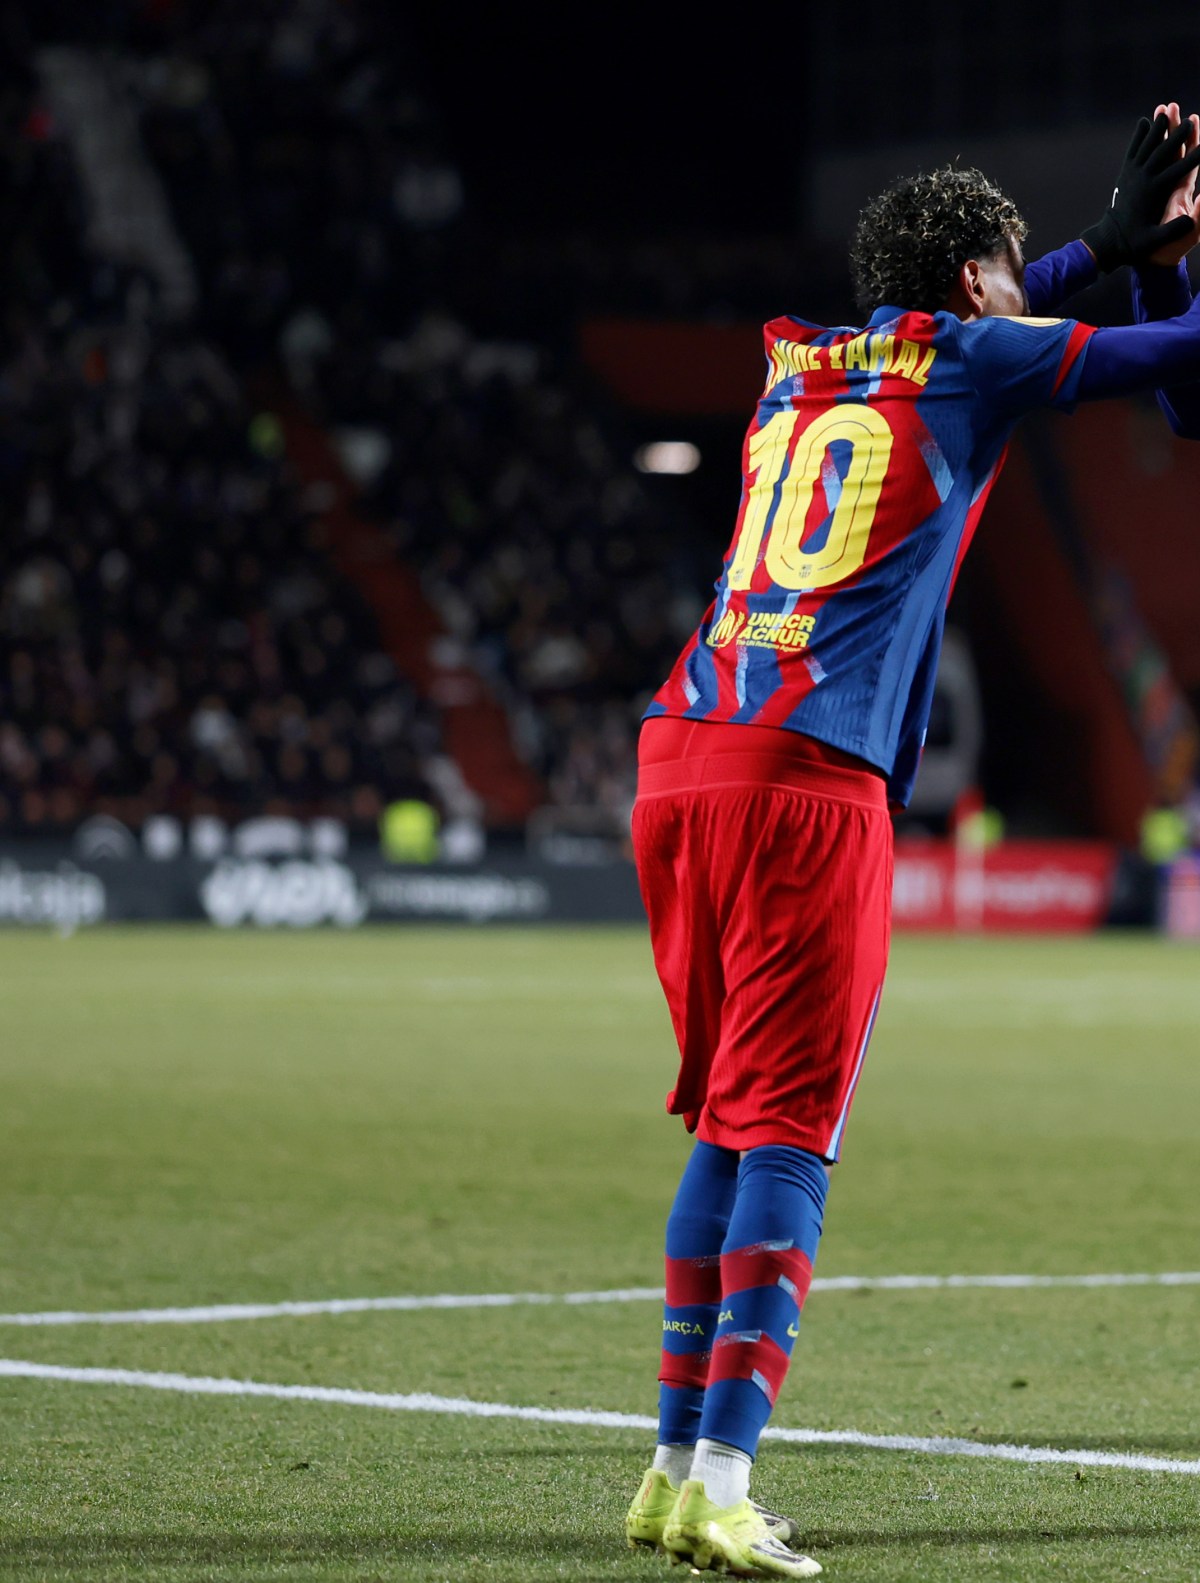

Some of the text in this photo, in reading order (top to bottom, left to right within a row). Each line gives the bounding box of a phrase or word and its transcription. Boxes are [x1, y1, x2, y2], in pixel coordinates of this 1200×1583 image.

[728, 403, 894, 591] 10
[747, 612, 816, 633] UNHCR
[736, 626, 810, 648] ACNUR
